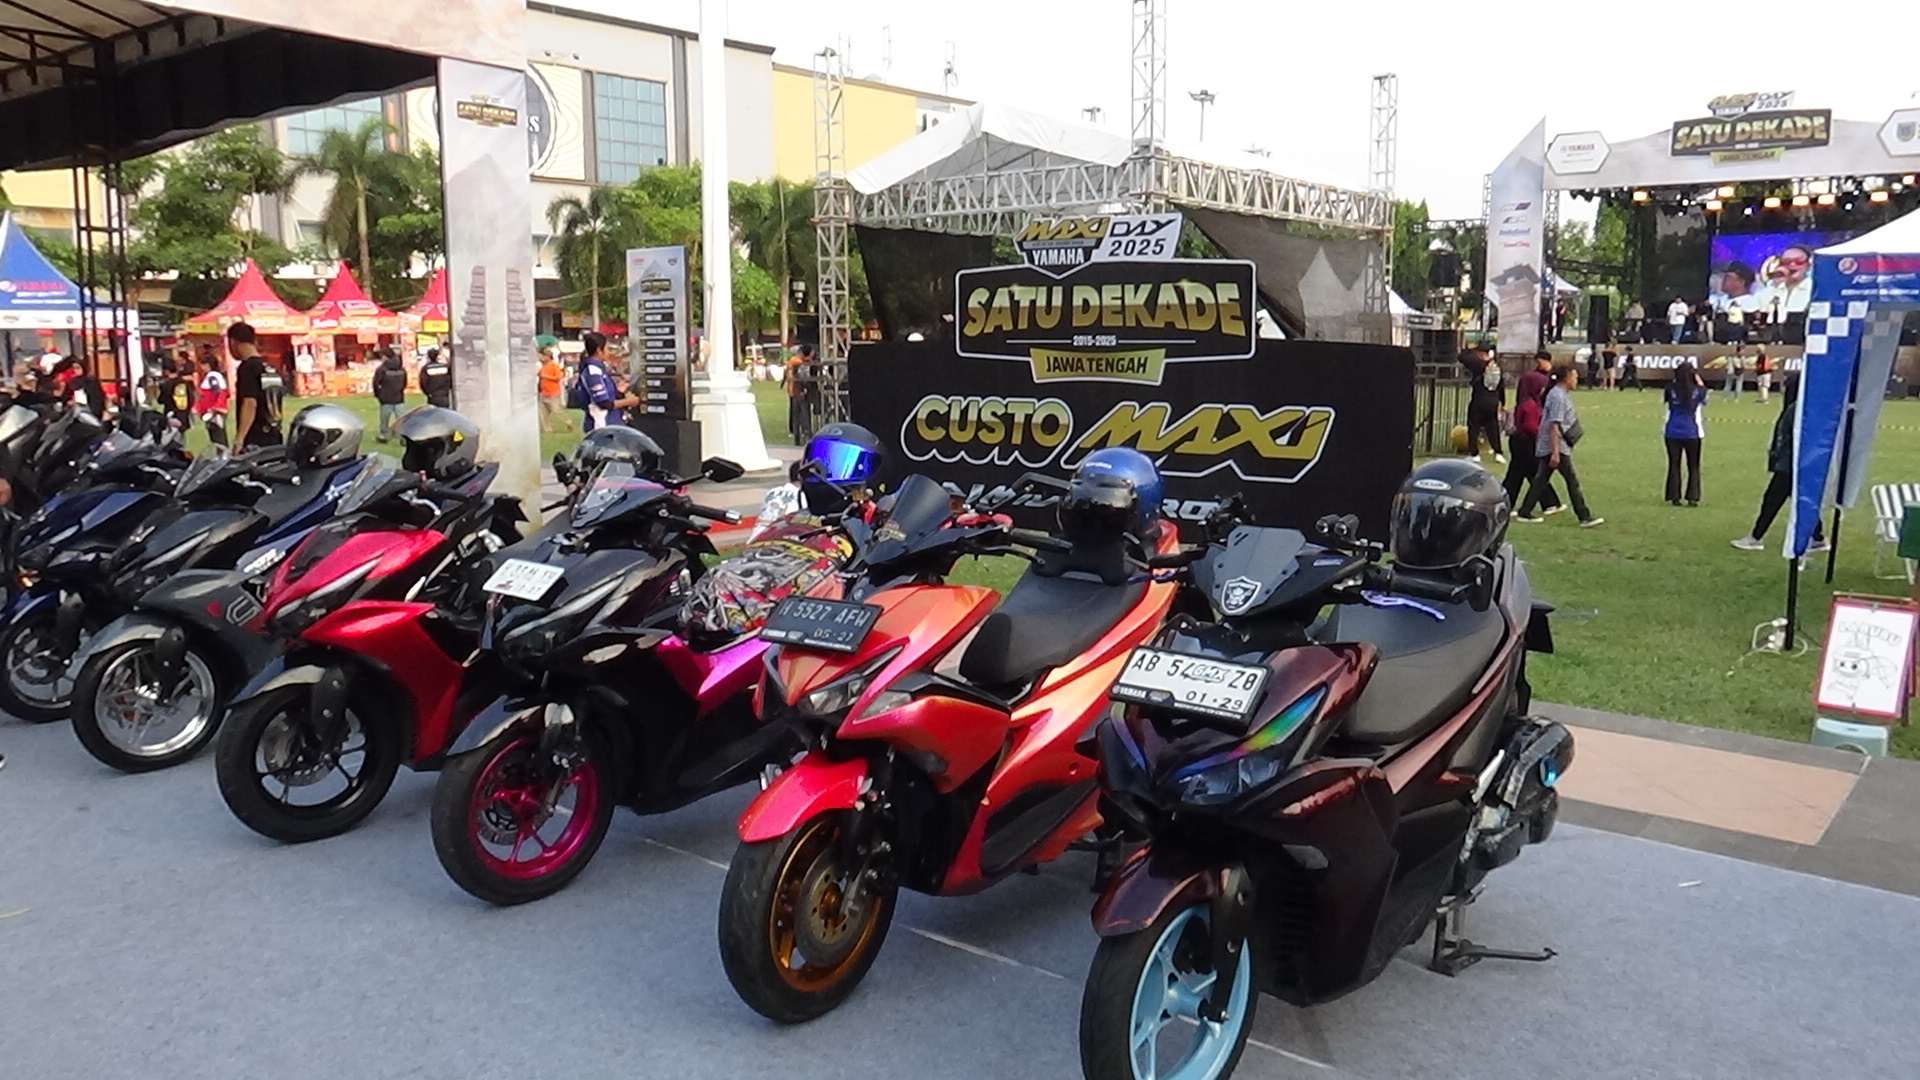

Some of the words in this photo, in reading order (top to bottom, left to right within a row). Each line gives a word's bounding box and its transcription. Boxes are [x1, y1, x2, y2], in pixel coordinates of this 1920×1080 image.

[1674, 123, 1731, 149] SATU
[1735, 116, 1827, 142] DEKADE
[1016, 216, 1110, 241] MAXI
[1109, 219, 1178, 237] DAY
[1032, 247, 1085, 266] YAMAHA
[1108, 238, 1166, 257] 2025
[962, 284, 1064, 337] SATU
[1072, 282, 1246, 337] DEKADE
[1073, 335, 1117, 346] 2015-2025
[1046, 356, 1086, 373] JAWA
[1087, 356, 1148, 375] TENGAH
[916, 398, 1071, 448] CUSTO
[1078, 405, 1332, 460] MAXI
[793, 602, 831, 621] 5527
[834, 607, 871, 627] AFW
[1132, 652, 1161, 671] AB
